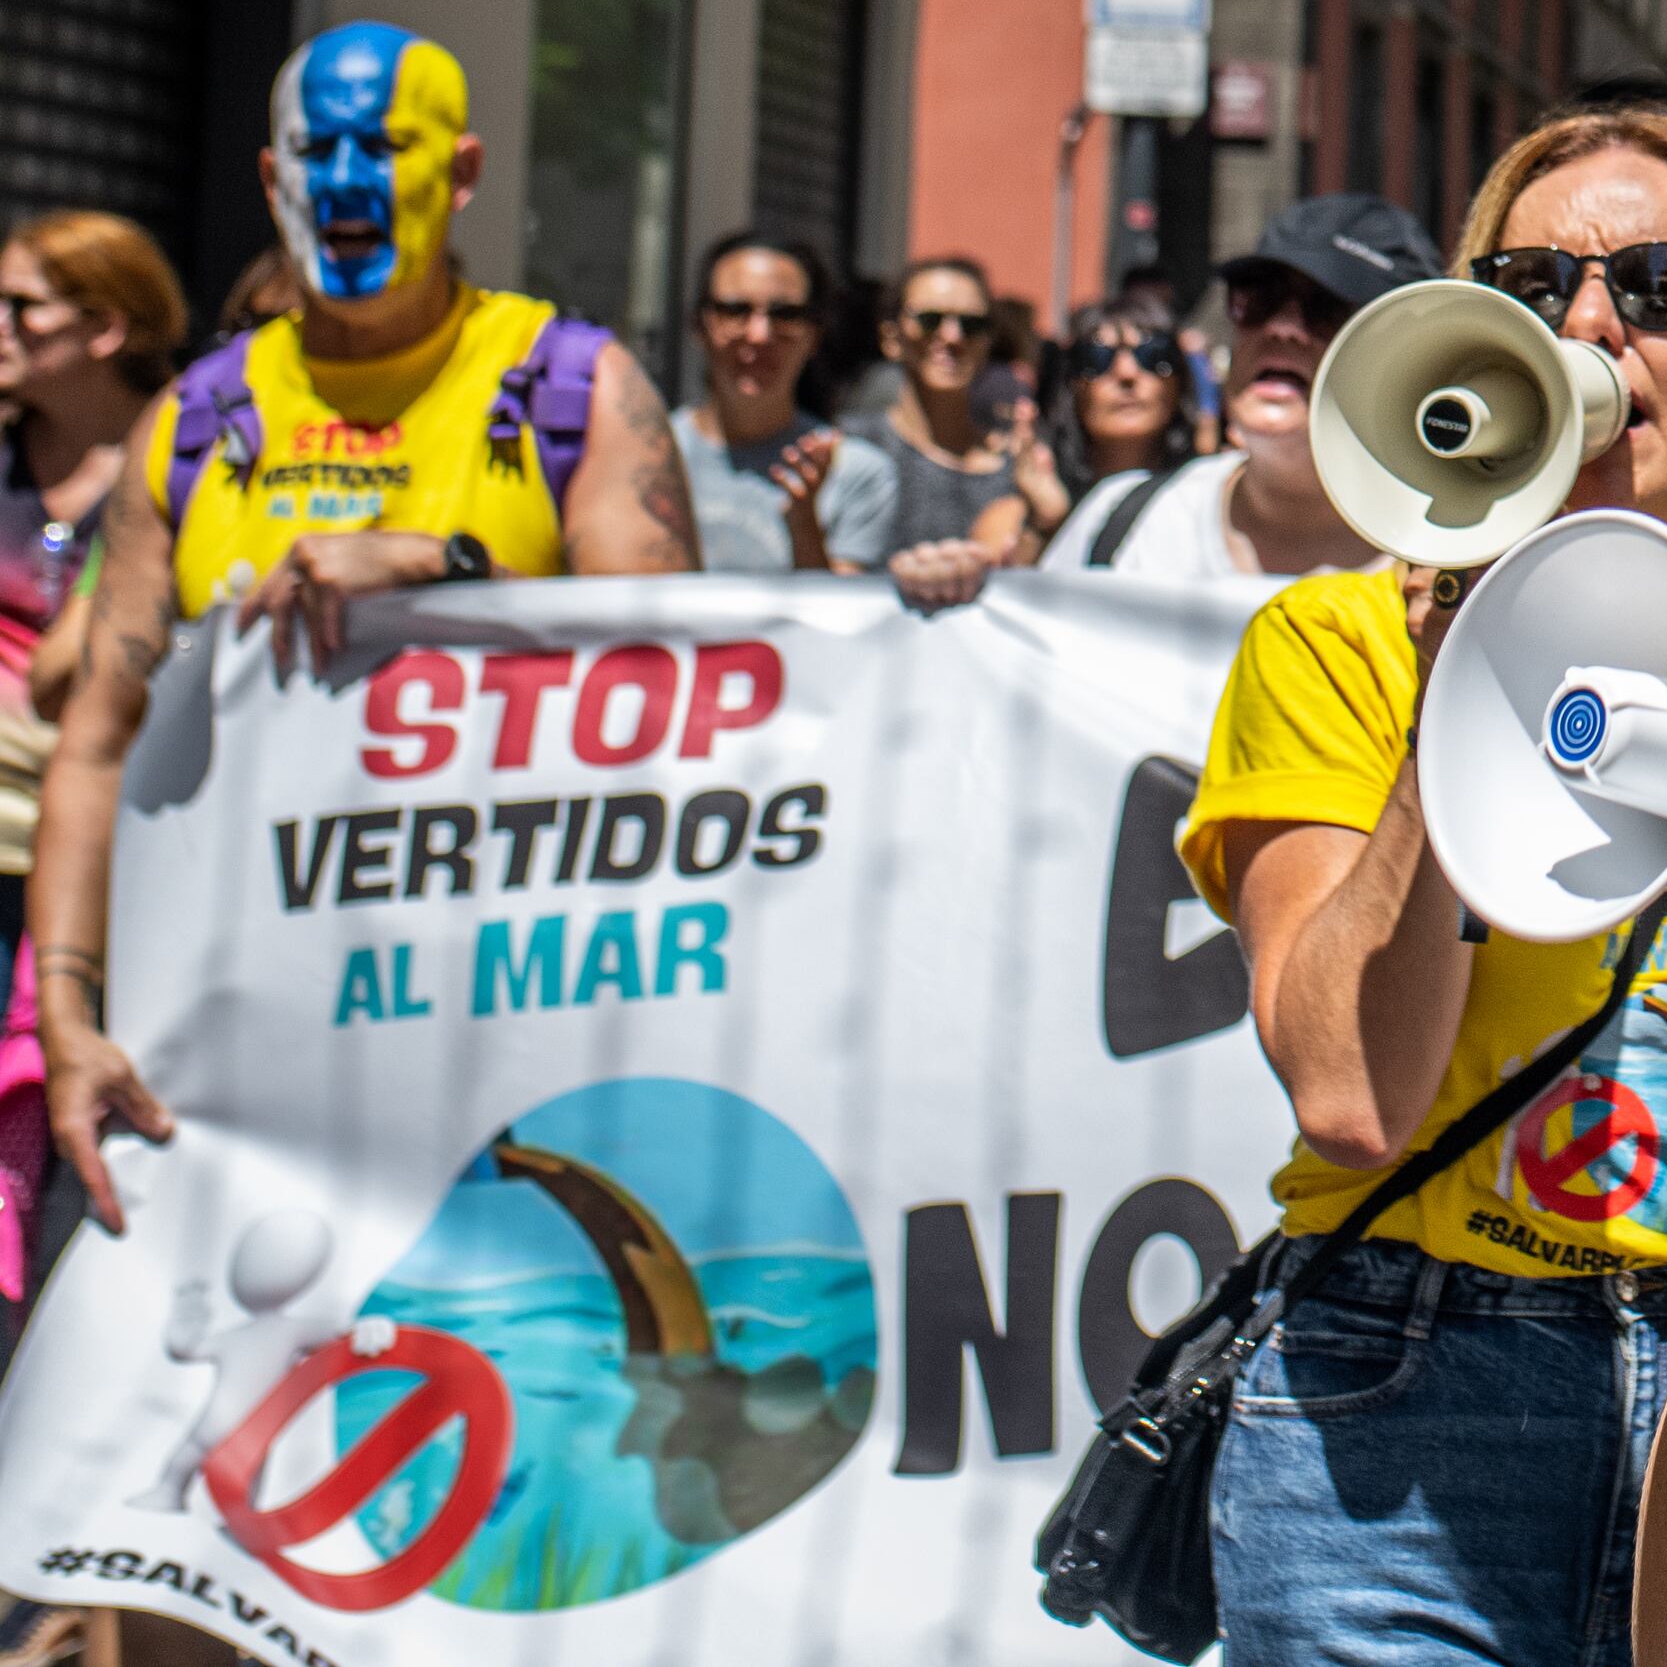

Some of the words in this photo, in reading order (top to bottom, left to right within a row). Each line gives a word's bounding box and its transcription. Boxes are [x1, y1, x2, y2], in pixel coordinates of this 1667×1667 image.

[360, 640, 783, 781] STOP
[272, 783, 828, 914] VERTIDOS
[332, 942, 432, 1028] AL
[469, 900, 729, 1019] MAR
